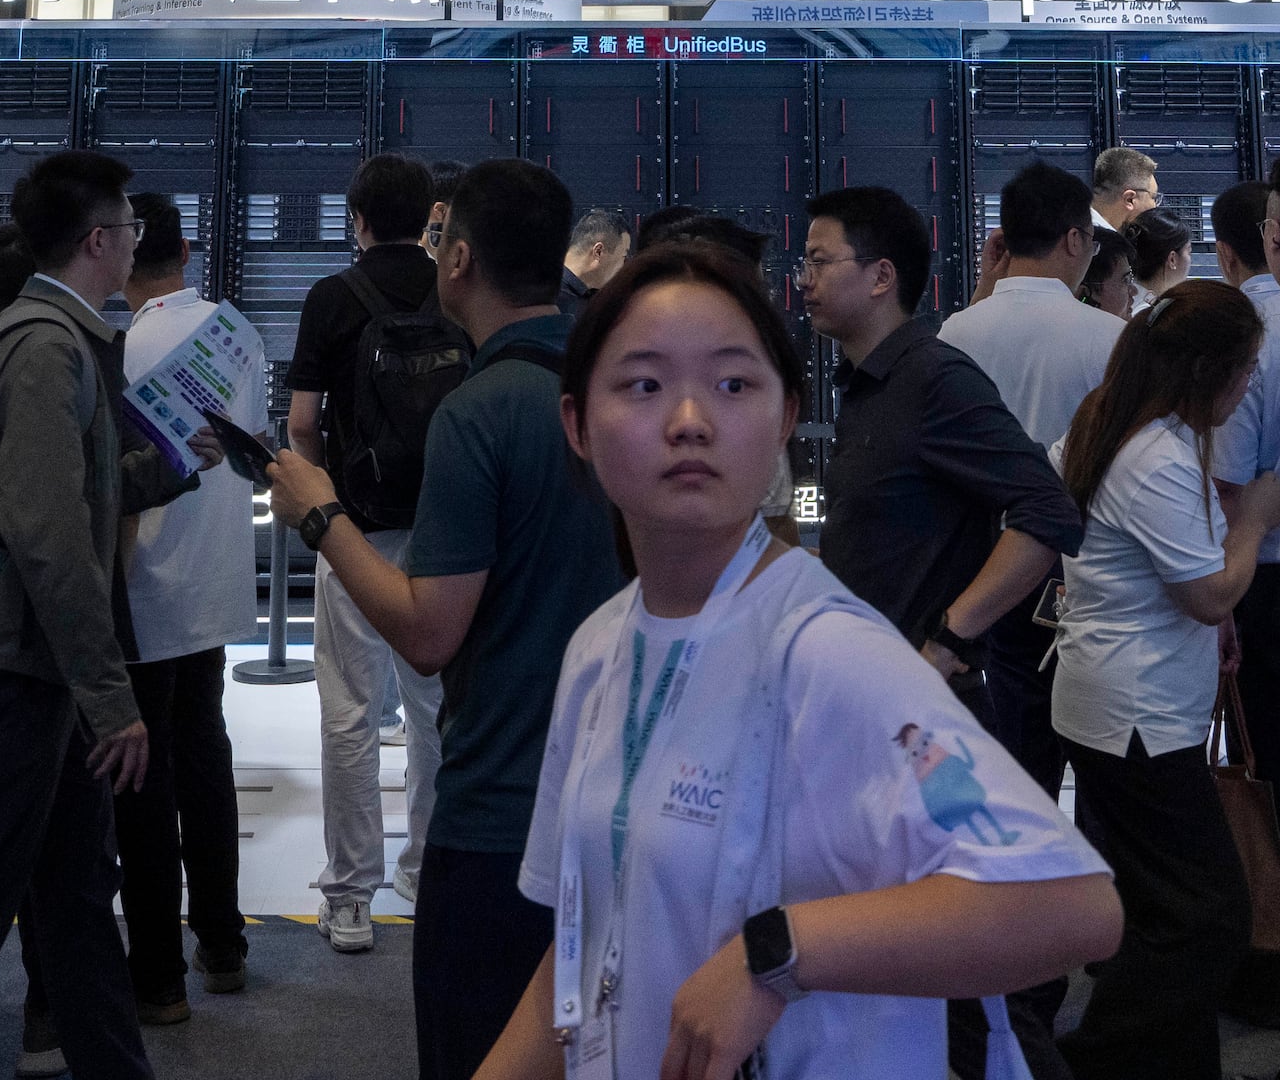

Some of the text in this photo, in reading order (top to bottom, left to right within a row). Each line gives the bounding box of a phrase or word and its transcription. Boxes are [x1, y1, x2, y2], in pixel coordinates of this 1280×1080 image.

[164, 0, 203, 10] Inference
[1080, 14, 1117, 23] Source
[1121, 14, 1130, 23] &
[1134, 14, 1164, 24] Open
[1167, 14, 1208, 24] Systems
[572, 36, 767, 54] 灵衢柜 UnifiedBus
[669, 780, 724, 809] WAIC
